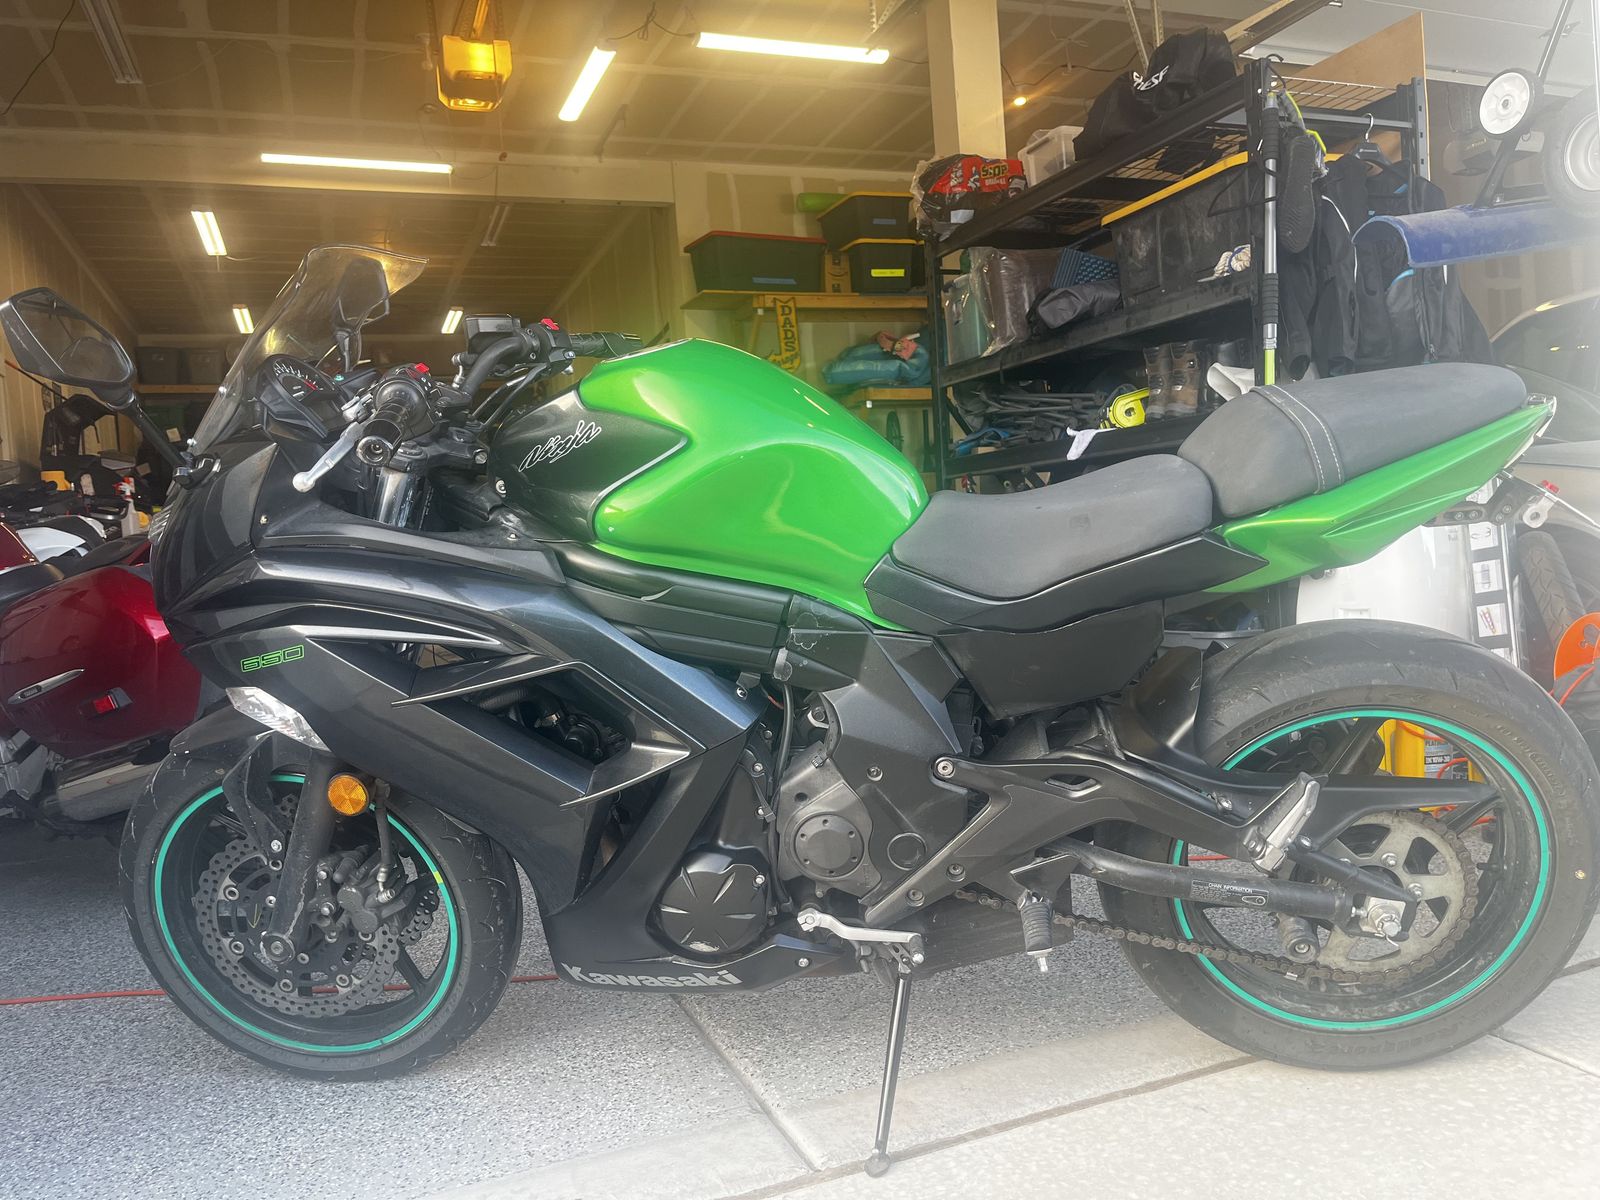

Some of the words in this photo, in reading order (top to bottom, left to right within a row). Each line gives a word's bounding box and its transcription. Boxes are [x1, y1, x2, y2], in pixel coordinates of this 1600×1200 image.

[780, 304, 797, 352] DADS
[518, 419, 602, 473] Ninja
[240, 644, 305, 673] 650
[560, 962, 743, 987] Kawasaki
